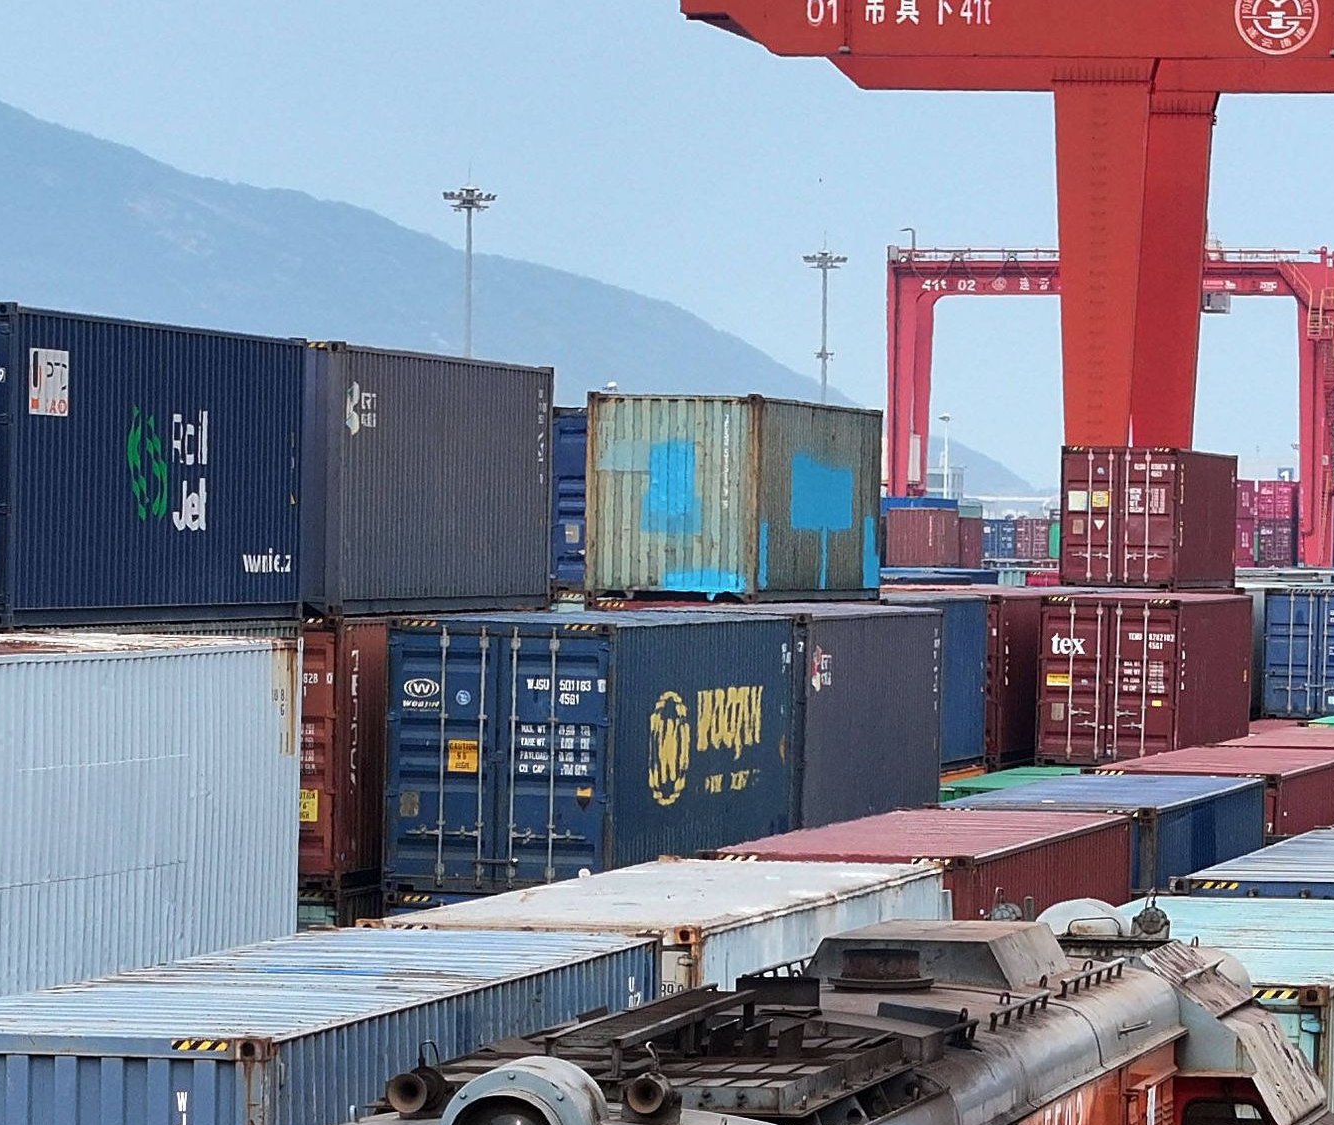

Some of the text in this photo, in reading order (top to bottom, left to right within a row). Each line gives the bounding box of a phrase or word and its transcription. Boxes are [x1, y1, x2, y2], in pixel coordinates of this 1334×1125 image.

[958, 280, 976, 291] 02
[1051, 633, 1086, 655] tex
[526, 678, 550, 690] WJSU
